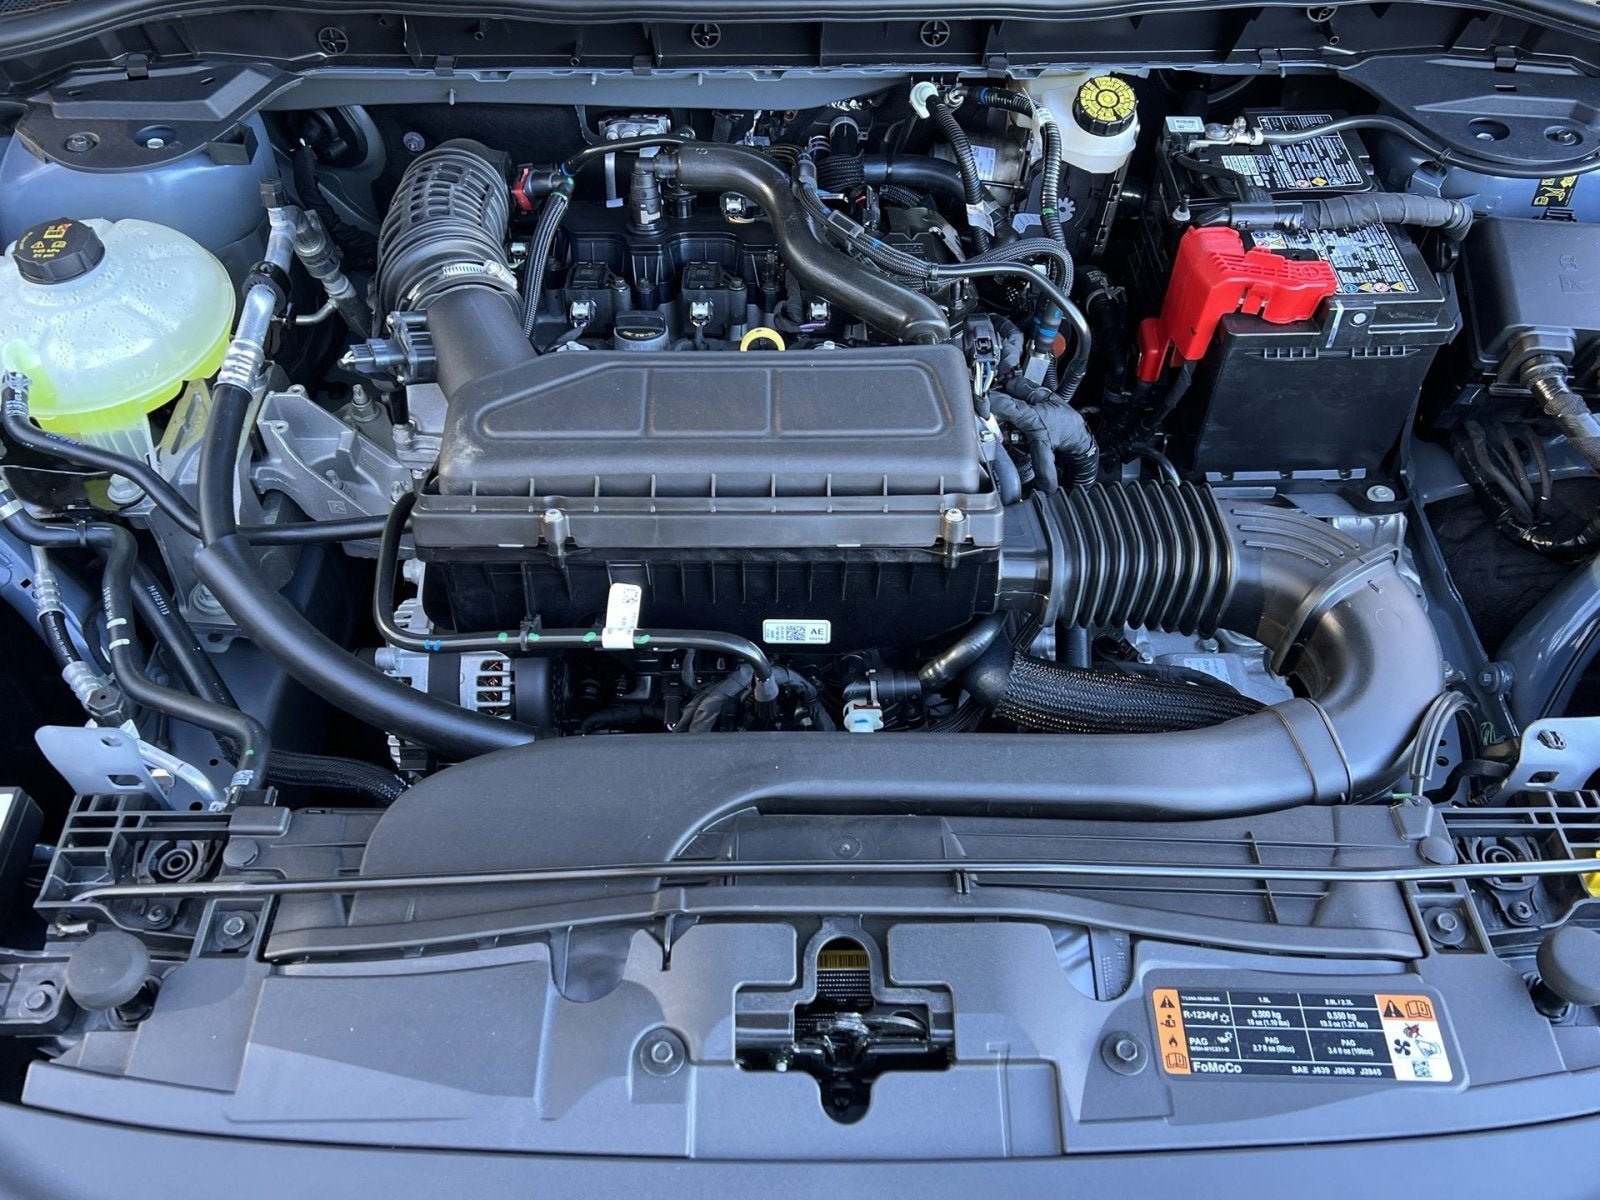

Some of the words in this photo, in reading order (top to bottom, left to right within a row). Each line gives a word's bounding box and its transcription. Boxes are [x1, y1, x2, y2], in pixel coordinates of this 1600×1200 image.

[1183, 1010, 1219, 1021] R-1234yf
[1271, 1010, 1282, 1021] kg
[1347, 1011, 1357, 1021] kg
[1189, 1037, 1209, 1046] PAG
[1264, 1037, 1280, 1045] PAG
[1340, 1039, 1357, 1047] PAG
[1193, 1061, 1243, 1074] FoMoCo
[1291, 1065, 1310, 1075] SAE
